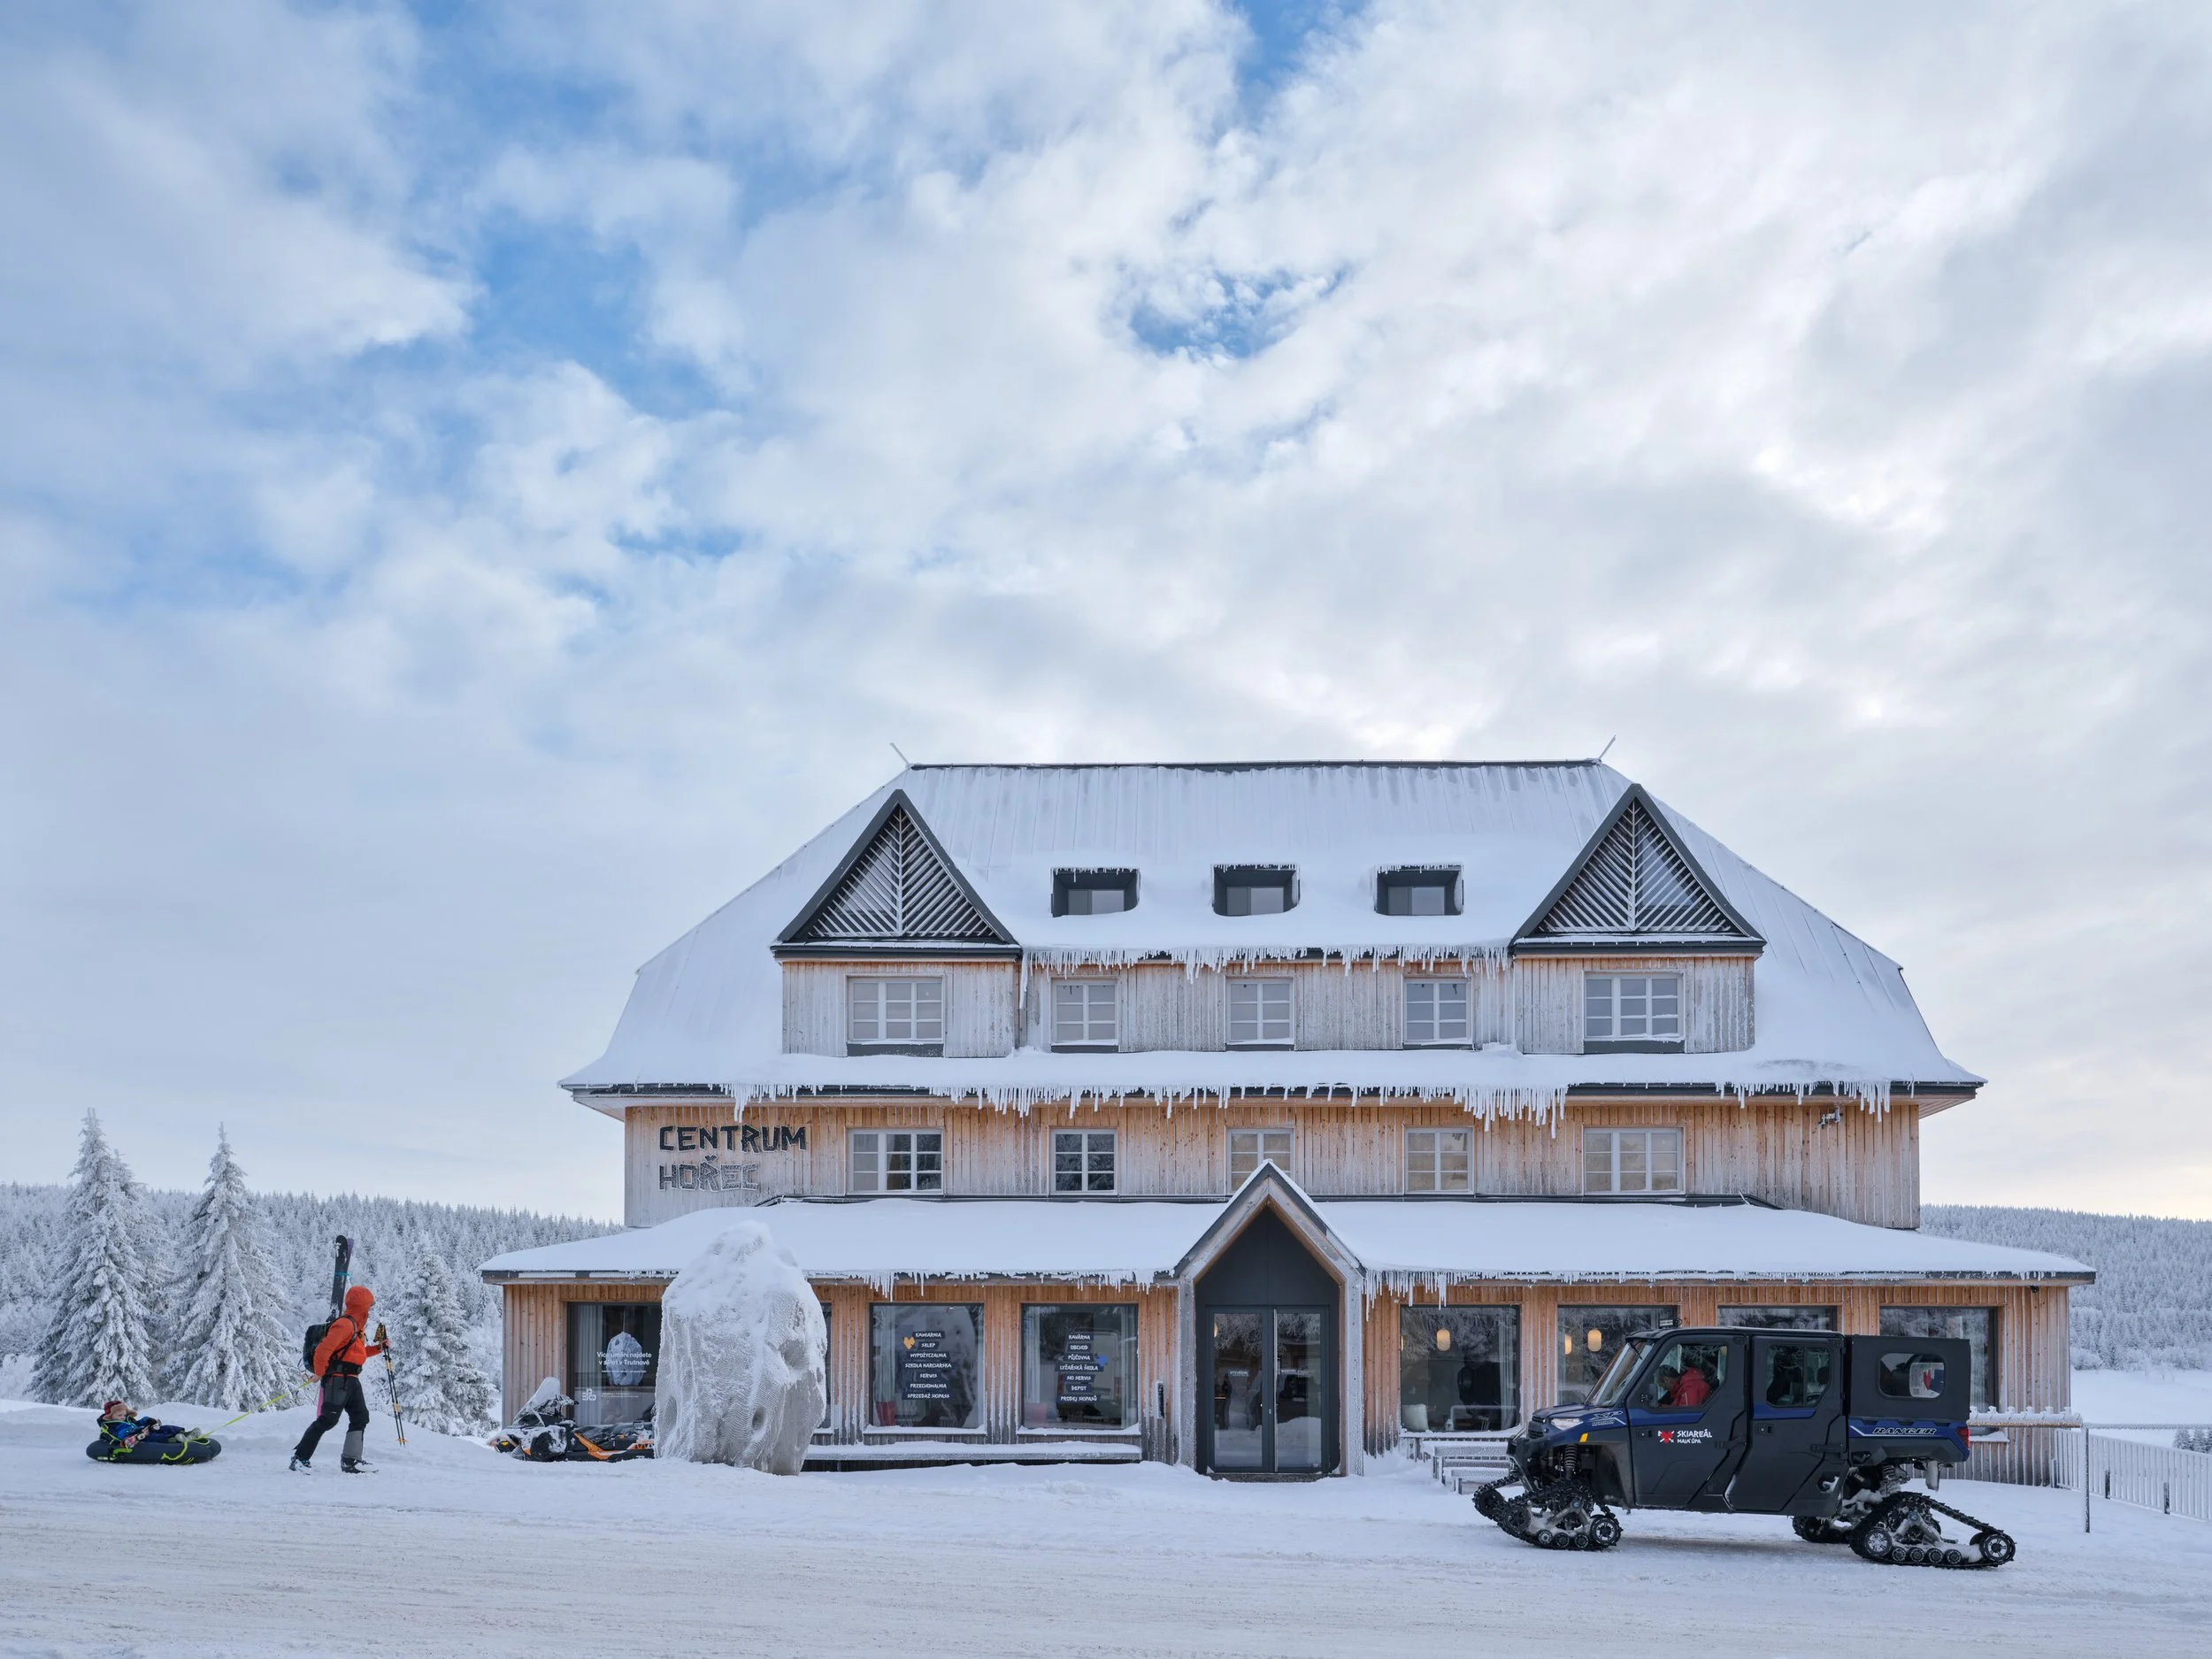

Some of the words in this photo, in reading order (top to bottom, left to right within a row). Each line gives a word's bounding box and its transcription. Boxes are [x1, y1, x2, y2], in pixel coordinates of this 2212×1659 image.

[659, 1125, 807, 1153] CENTRUM
[659, 1154, 760, 1192] HOŘEC
[1677, 1428, 1713, 1438] SKIAREÁL
